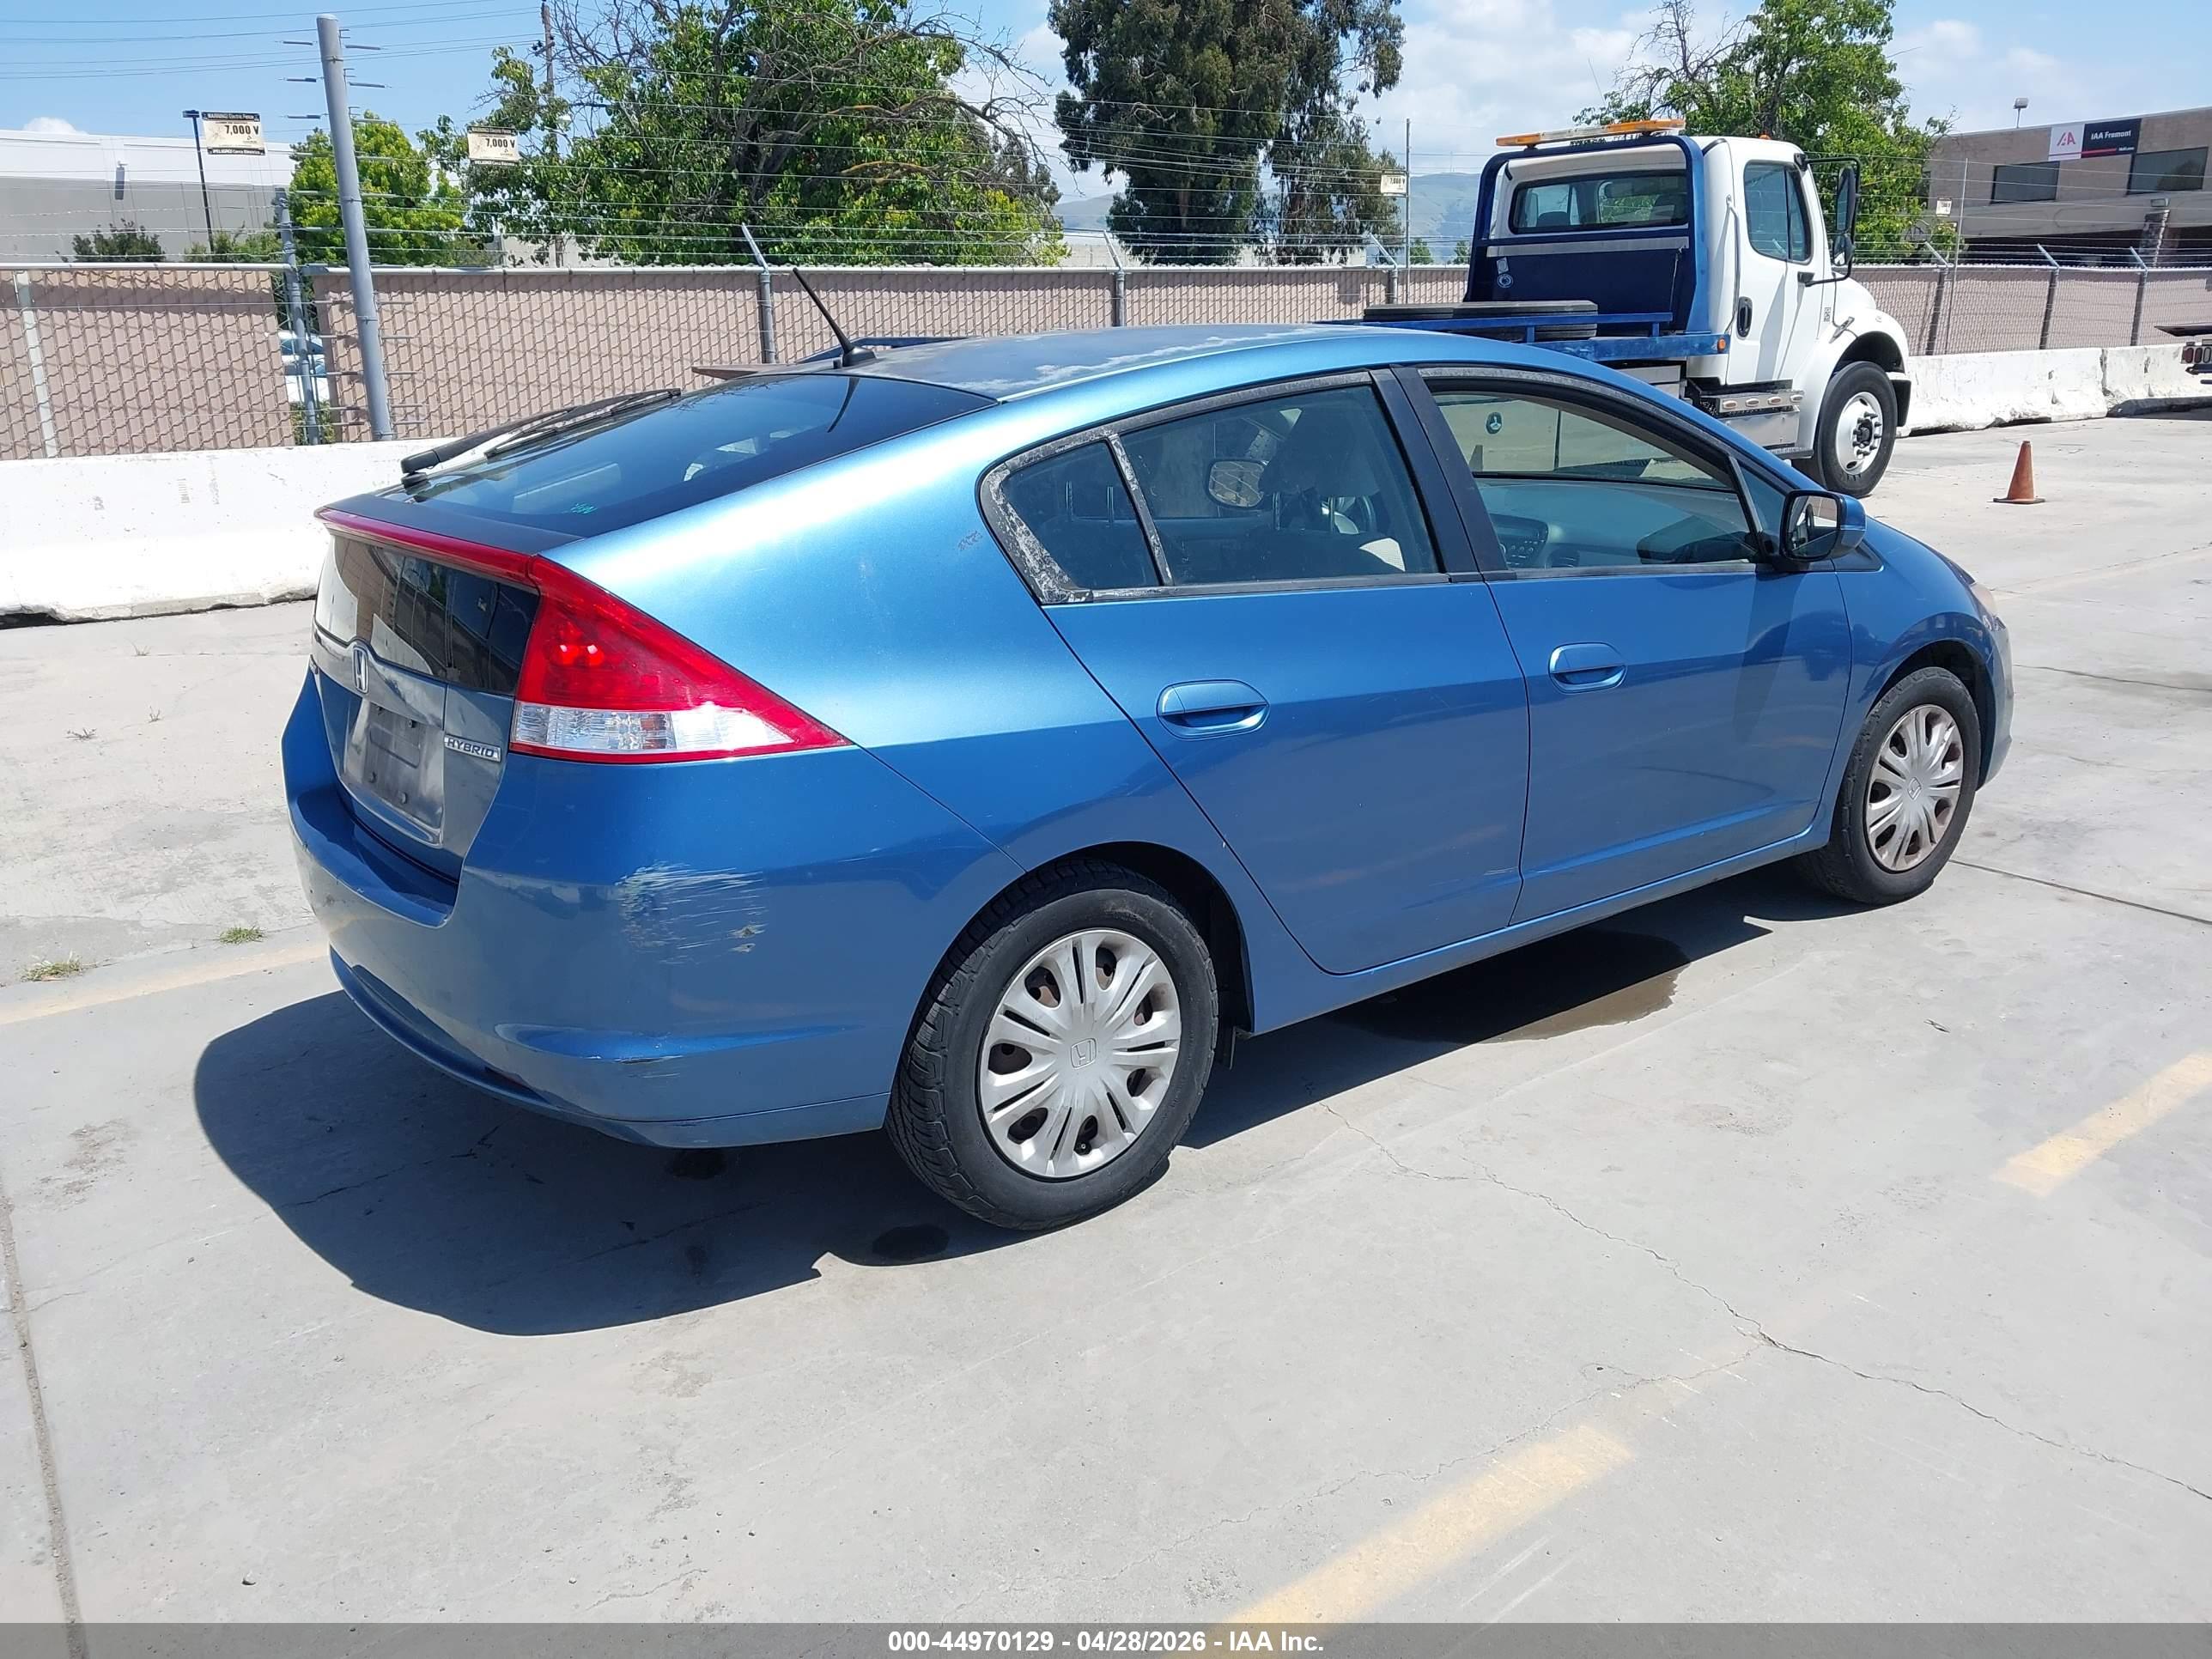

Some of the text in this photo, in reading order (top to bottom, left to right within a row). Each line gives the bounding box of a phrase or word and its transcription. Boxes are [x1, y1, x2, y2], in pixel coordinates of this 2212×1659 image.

[224, 125, 259, 135] 7,000 V
[2090, 130, 2131, 140] IAA Fremont
[485, 138, 515, 148] 7,000 V
[447, 738, 495, 757] HYBRID
